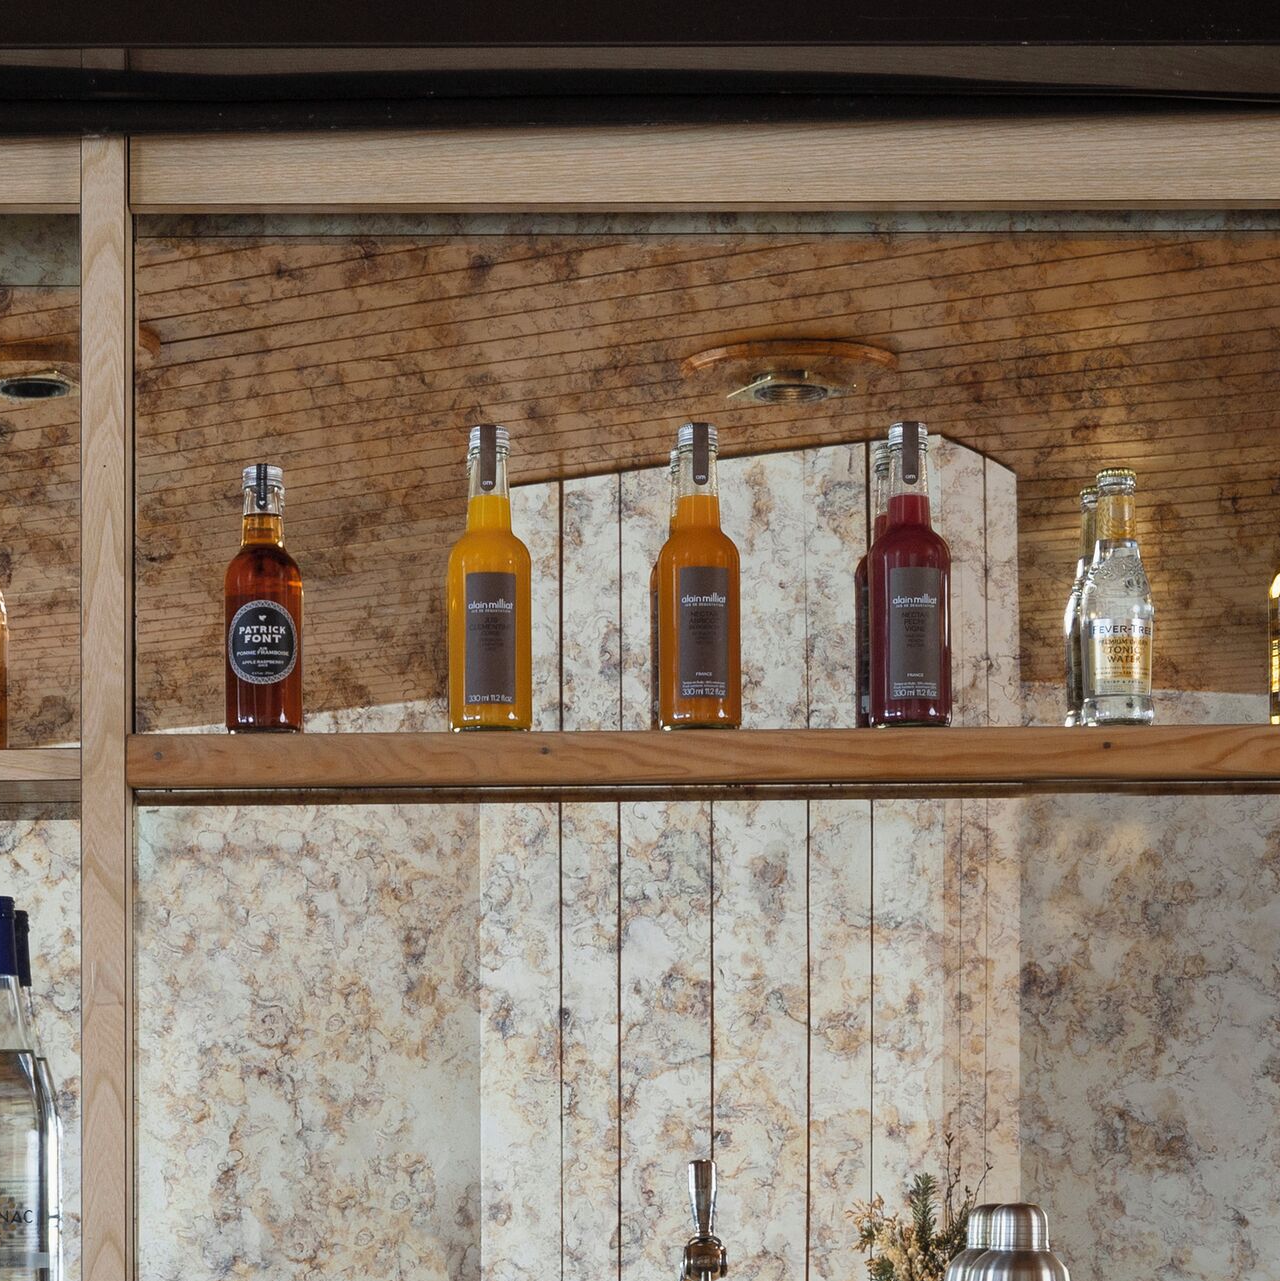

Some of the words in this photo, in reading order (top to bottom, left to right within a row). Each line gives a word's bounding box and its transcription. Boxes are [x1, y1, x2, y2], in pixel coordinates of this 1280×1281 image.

[681, 594, 701, 604] alain
[702, 592, 726, 604] milliat
[892, 596, 913, 605] alain
[914, 593, 937, 604] milliat
[468, 601, 488, 611] alain
[489, 598, 513, 610] milliat
[238, 625, 286, 635] PATRICK
[244, 634, 281, 644] FONT
[1108, 646, 1141, 654] TONIC
[1107, 655, 1141, 663] WATER
